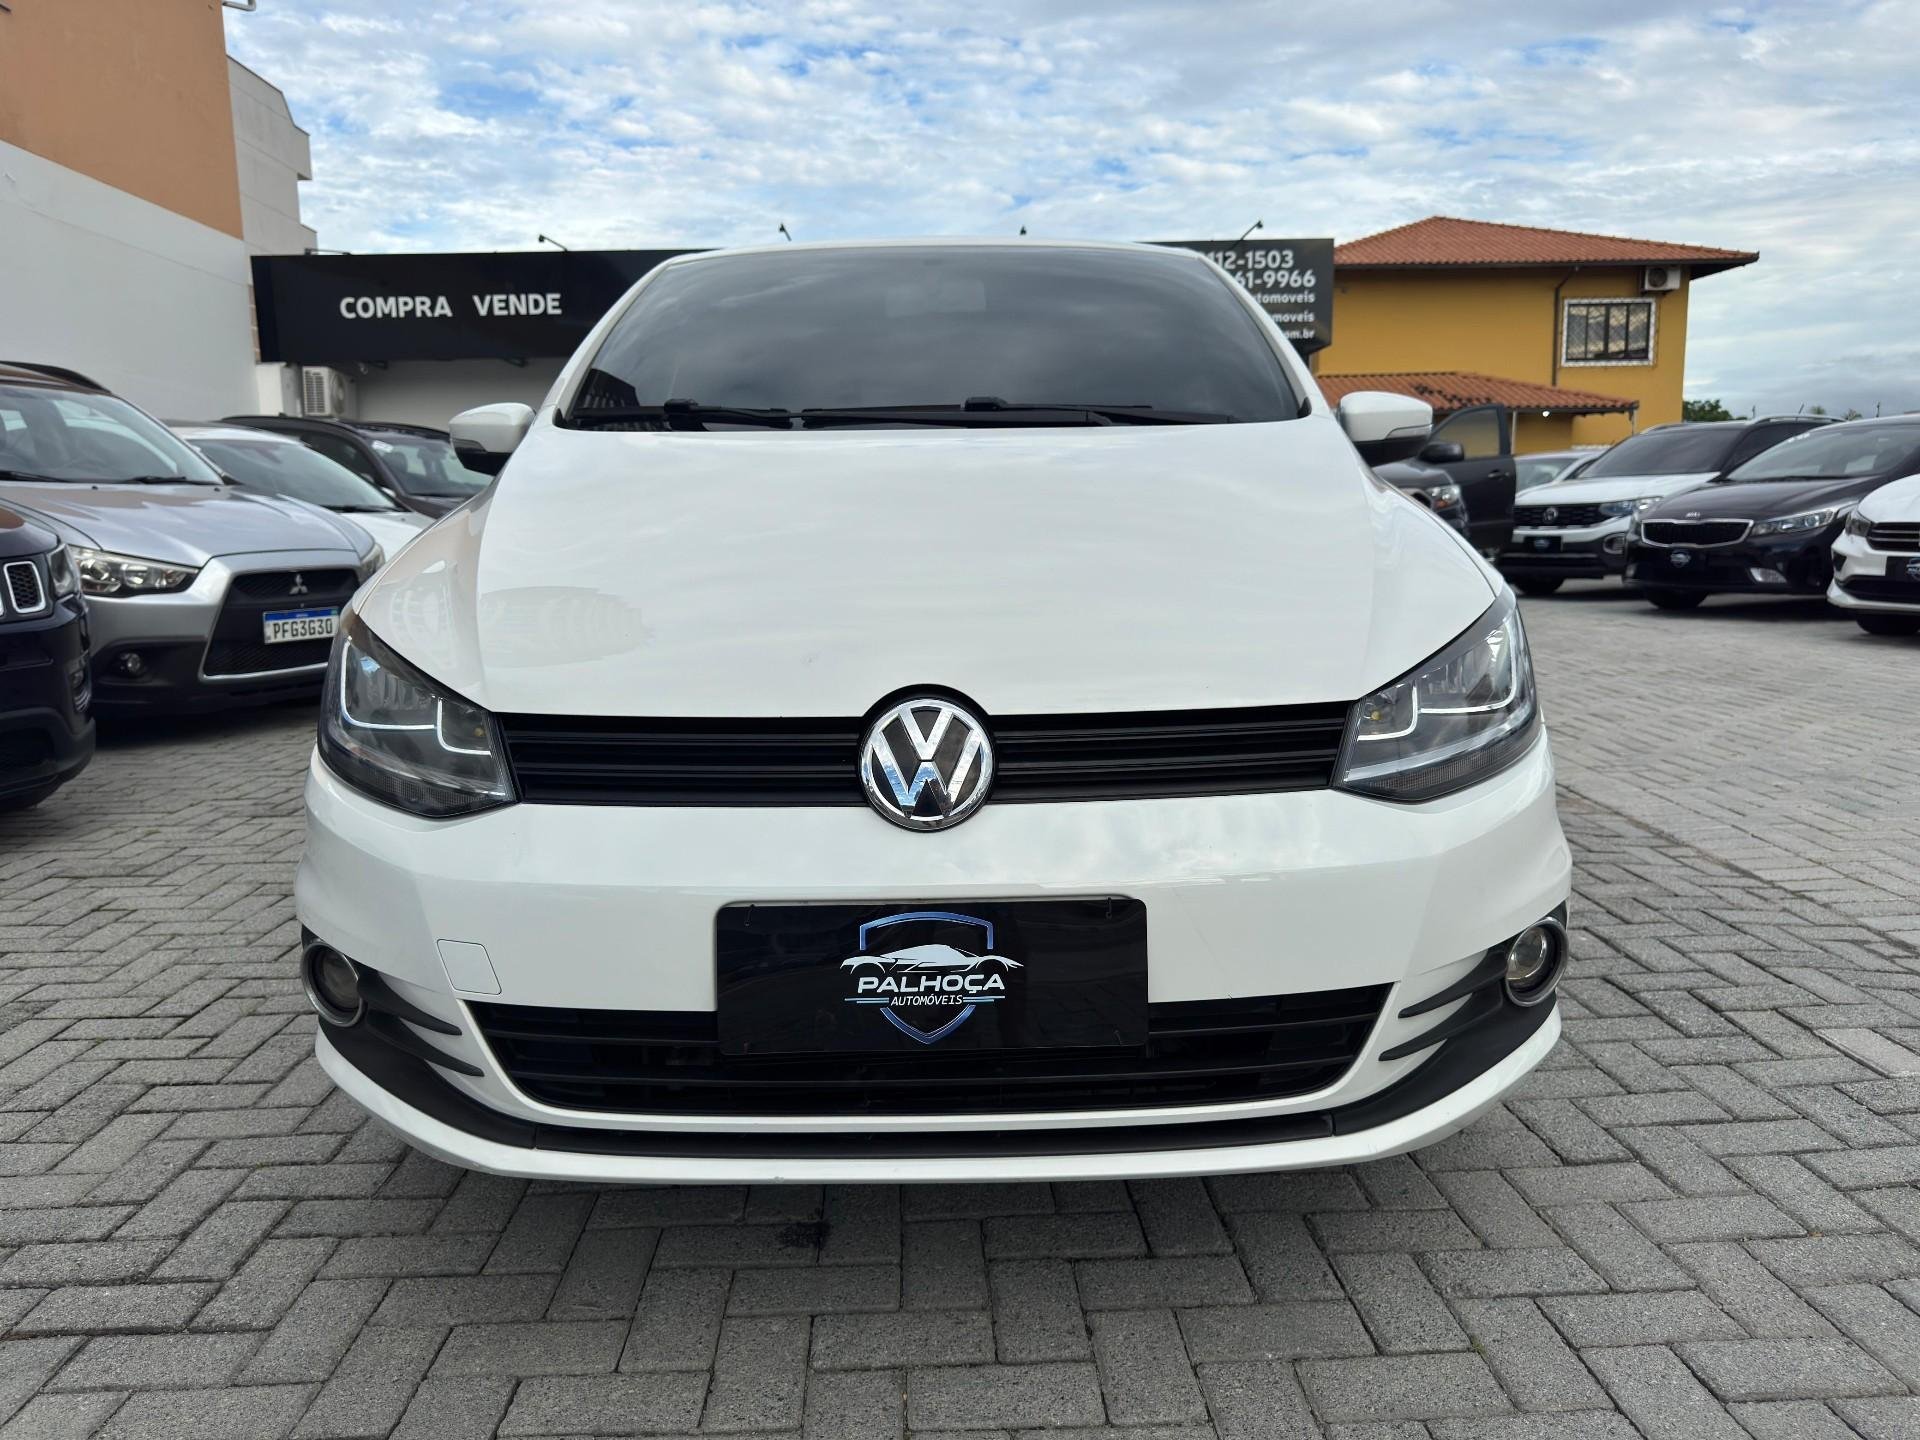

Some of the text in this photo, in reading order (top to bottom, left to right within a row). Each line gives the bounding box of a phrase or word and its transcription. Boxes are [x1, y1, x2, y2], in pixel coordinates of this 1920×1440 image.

[1206, 250, 1294, 269] 112-1503
[1234, 269, 1316, 288] 61-9966
[340, 293, 562, 319] COMPRA VENDE
[1254, 290, 1315, 304] tomoveis
[1272, 309, 1315, 323] moveis
[1284, 328, 1315, 339] om.br
[273, 618, 333, 640] PFG3G30
[857, 973, 1005, 993] PALHOÇA
[891, 994, 963, 1006] AUTOMÓVEIS
